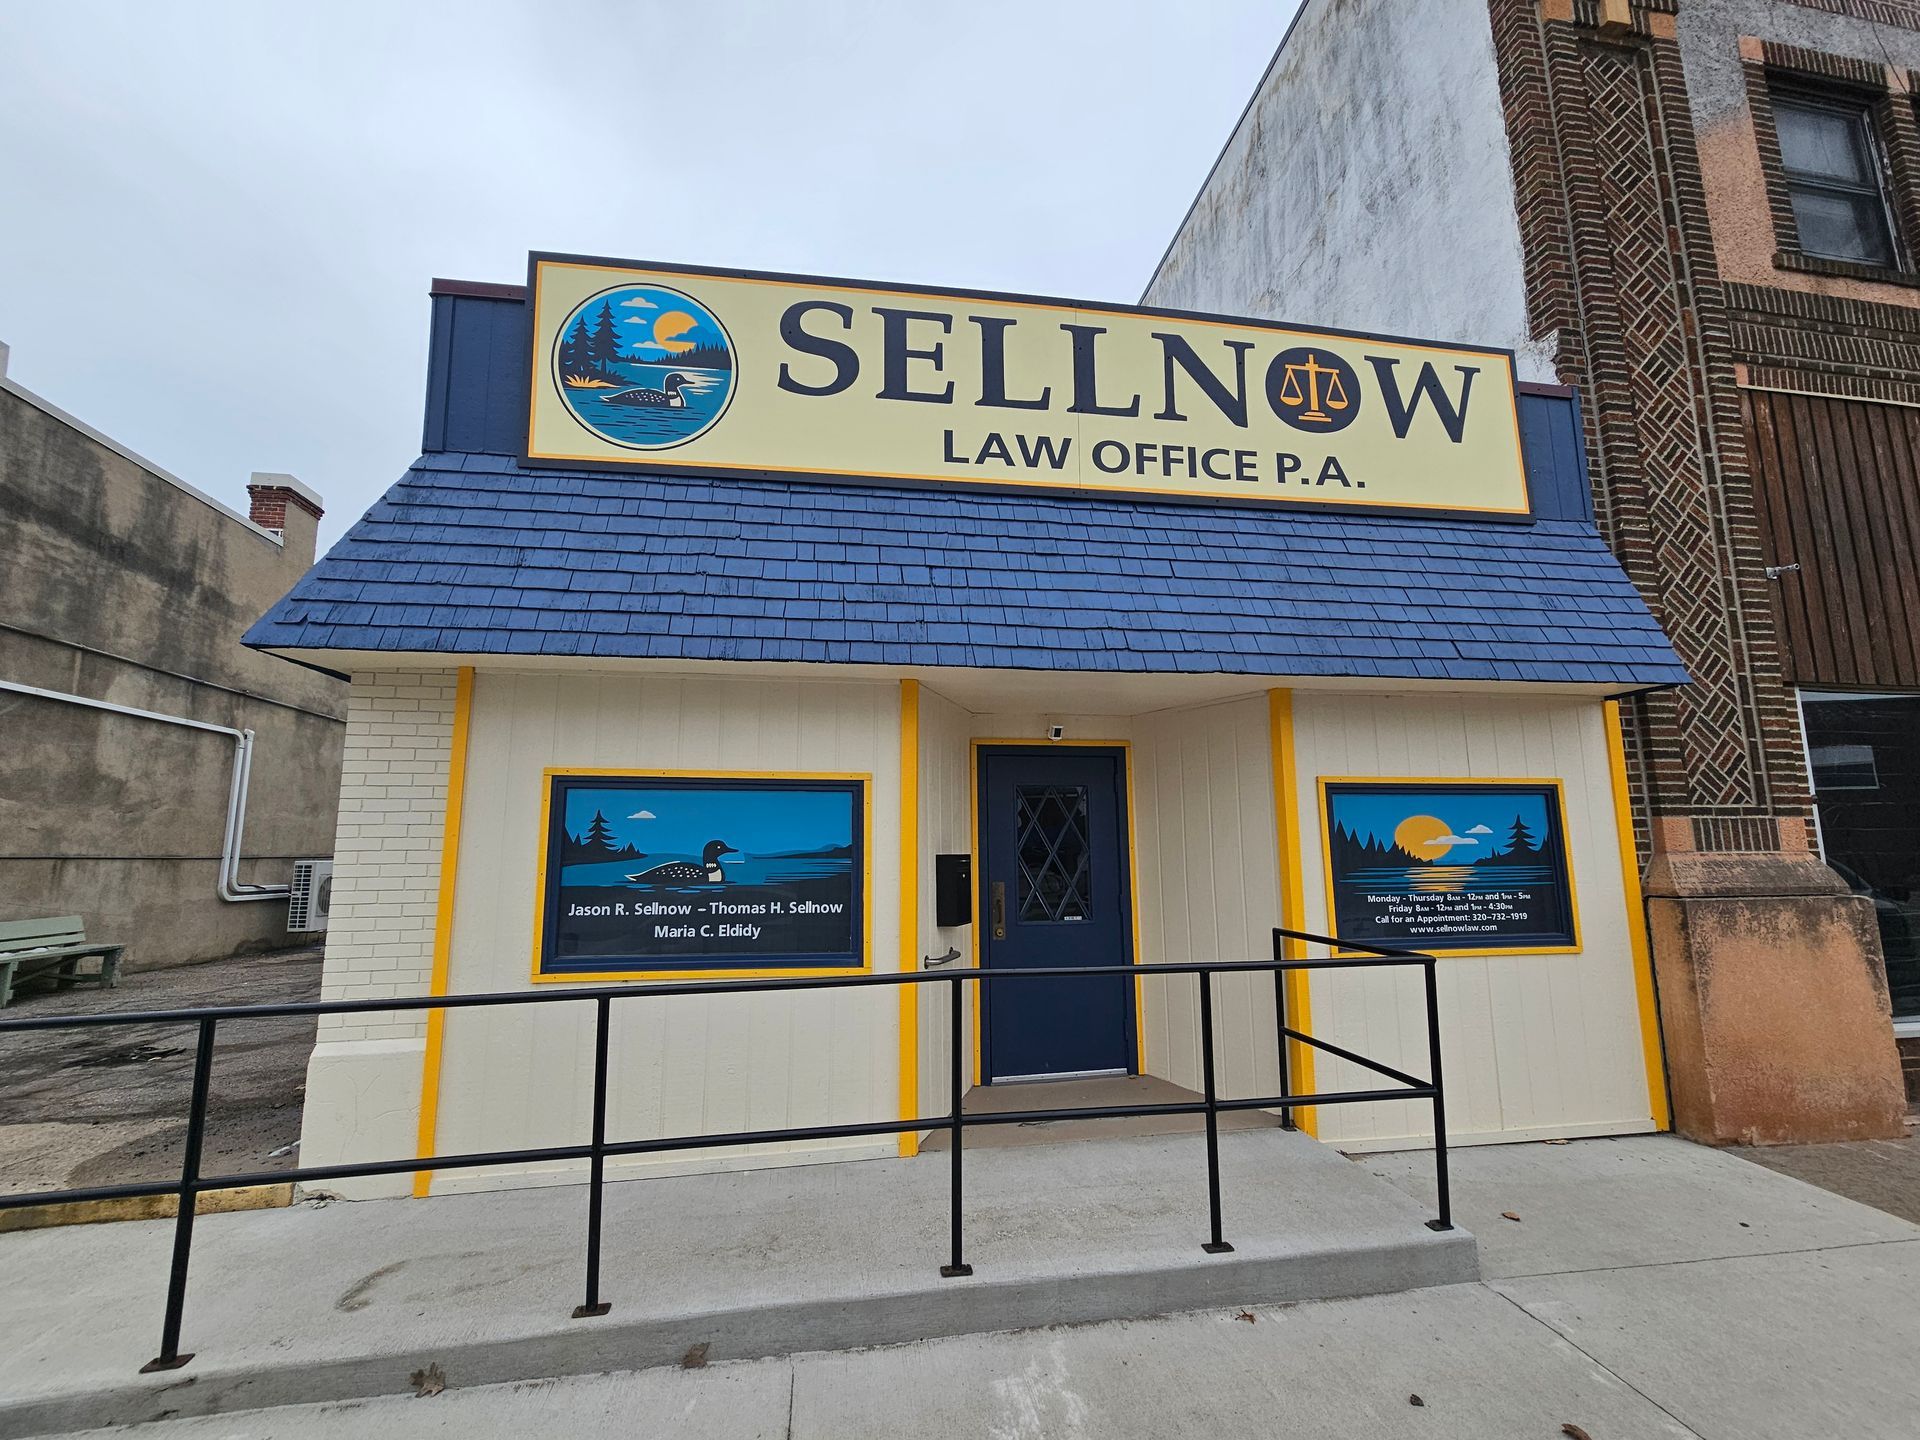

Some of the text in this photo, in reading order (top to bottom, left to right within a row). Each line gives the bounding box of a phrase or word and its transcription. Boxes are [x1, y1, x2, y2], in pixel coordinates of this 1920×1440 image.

[778, 301, 1482, 445] SELLNOW
[944, 430, 1365, 488] LAW OFFICE P.A.
[1368, 895, 1400, 903] Monday
[1408, 894, 1444, 902] Thursday
[568, 904, 610, 916] Jason
[615, 903, 629, 915] R.
[635, 902, 691, 915] Sellnow
[710, 902, 766, 914] Thomas
[771, 902, 784, 913] H.
[790, 901, 843, 913] Sellnow
[1389, 905, 1412, 913] Friday
[1454, 903, 1469, 911] and
[1391, 915, 1403, 923] for
[1417, 915, 1470, 924] Appointment:
[655, 924, 761, 939] Maria C. Eldidy
[1410, 924, 1497, 933] www.sellnowlaw.com
